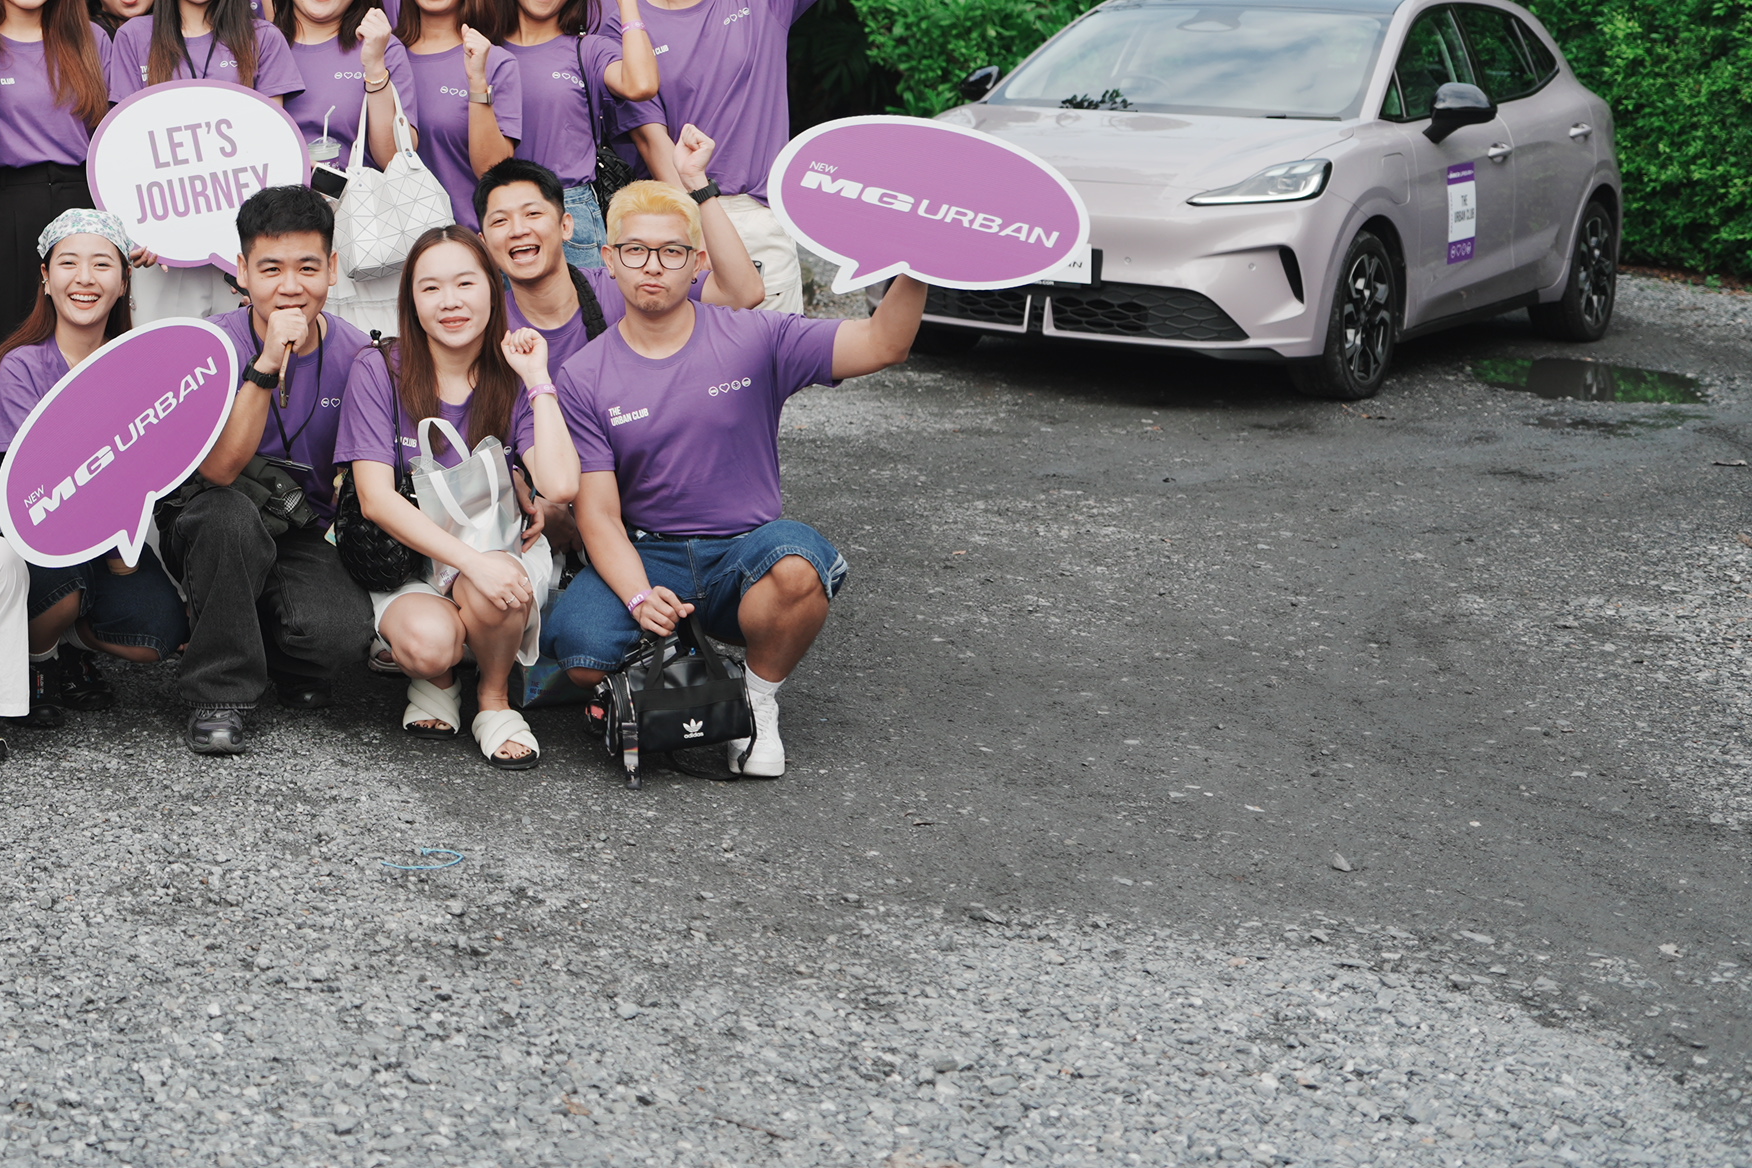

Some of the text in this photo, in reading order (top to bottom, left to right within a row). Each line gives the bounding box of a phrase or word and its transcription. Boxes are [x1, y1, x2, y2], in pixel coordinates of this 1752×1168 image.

[147, 118, 238, 169] LET'S
[809, 160, 838, 174] NEW
[800, 170, 1060, 249] MG URBAN
[608, 406, 622, 417] THE
[610, 408, 649, 427] URBAN CLUB
[28, 356, 218, 526] MG URBAN
[23, 485, 45, 508] NEW
[683, 731, 704, 739] adidas
